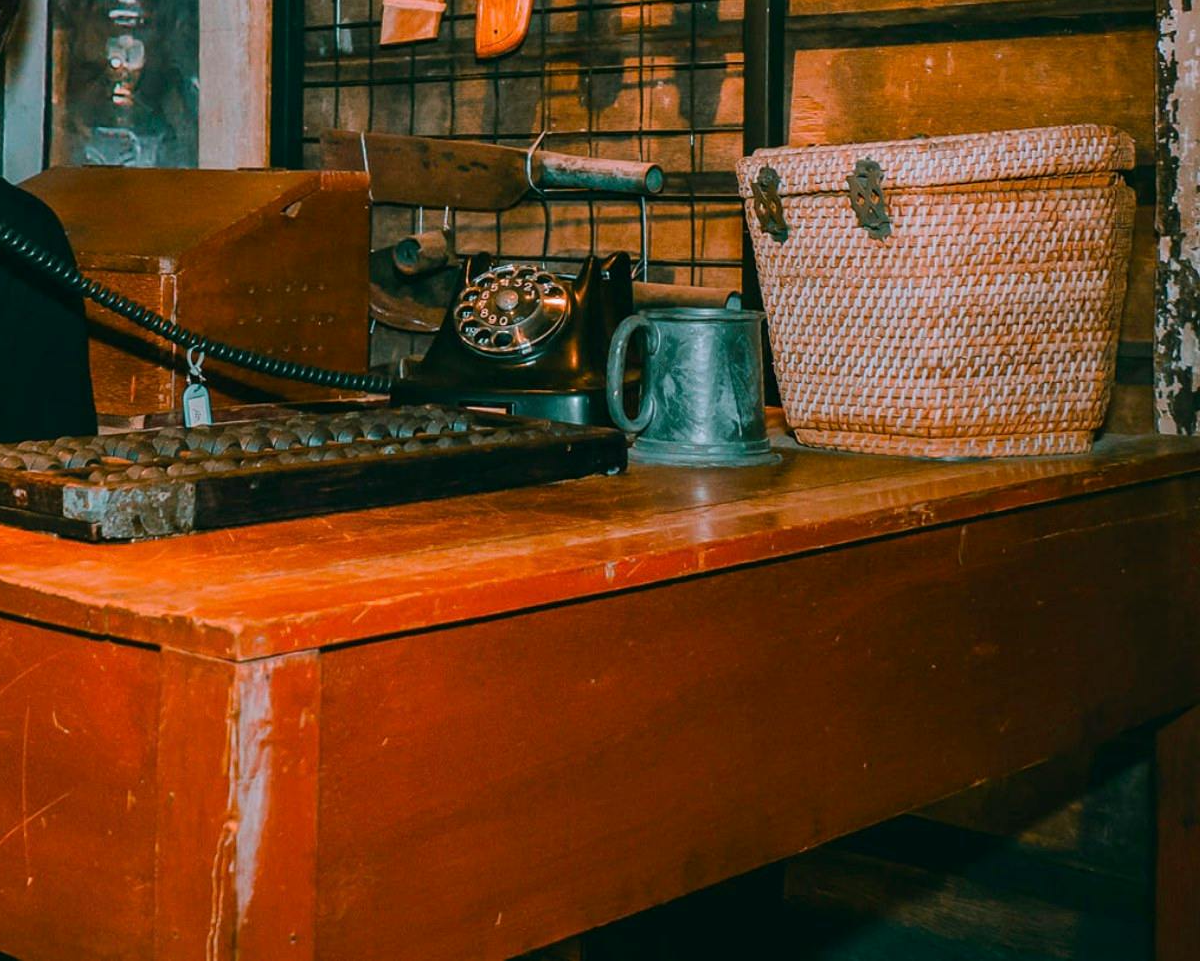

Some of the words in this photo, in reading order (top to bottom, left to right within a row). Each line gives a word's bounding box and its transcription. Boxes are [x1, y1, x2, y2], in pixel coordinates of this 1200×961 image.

[514, 279, 522, 287] 3
[523, 282, 532, 291] 2
[490, 284, 498, 292] 5
[482, 290, 489, 299] 6
[480, 308, 488, 317] 8
[488, 314, 497, 324] 9
[499, 316, 508, 326] 0
